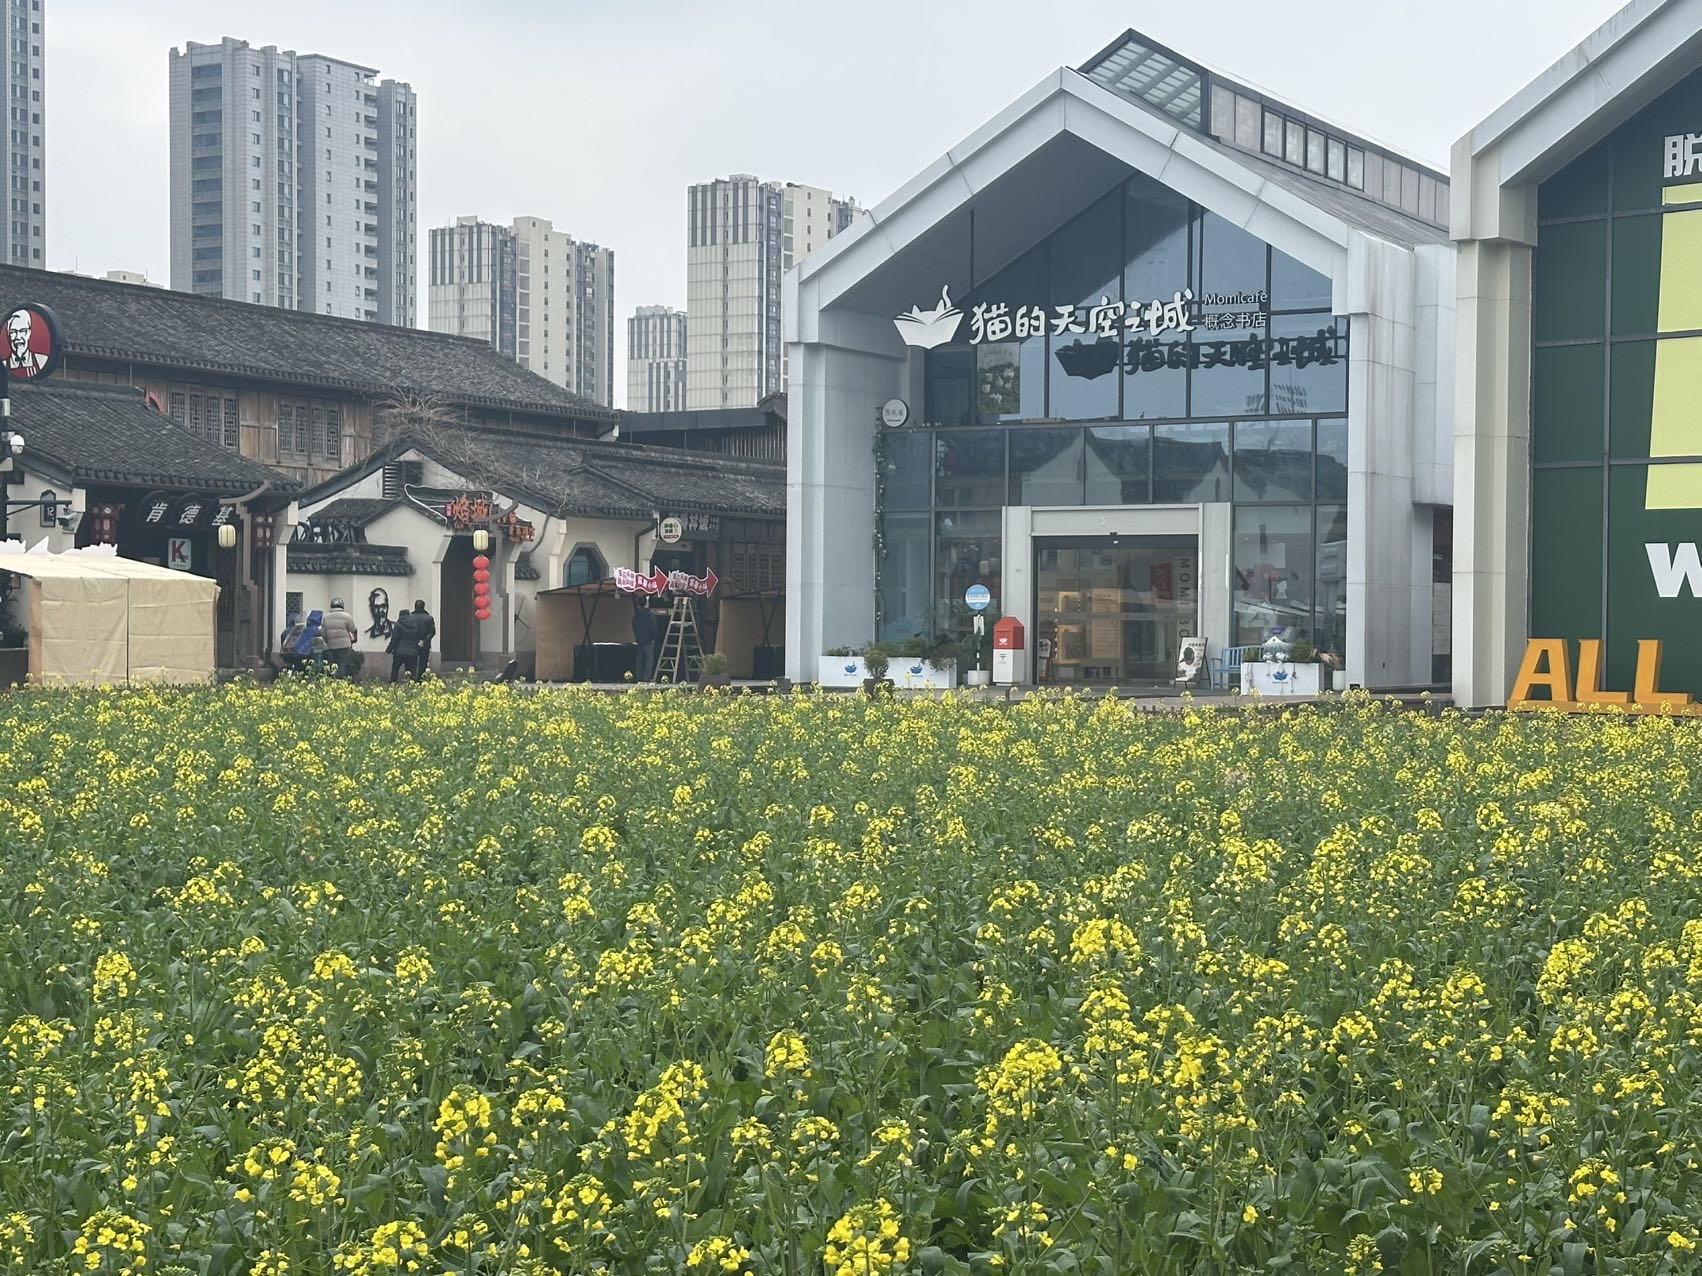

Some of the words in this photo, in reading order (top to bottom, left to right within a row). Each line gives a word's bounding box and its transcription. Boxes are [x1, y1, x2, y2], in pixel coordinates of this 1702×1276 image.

[1204, 290, 1268, 305] Momicafe
[969, 288, 1195, 345] 猫的天空之城
[1204, 312, 1267, 330] 概念书店
[146, 501, 234, 526] 肯德基
[1179, 558, 1191, 606] MOMI
[1508, 638, 1693, 705] ALL
